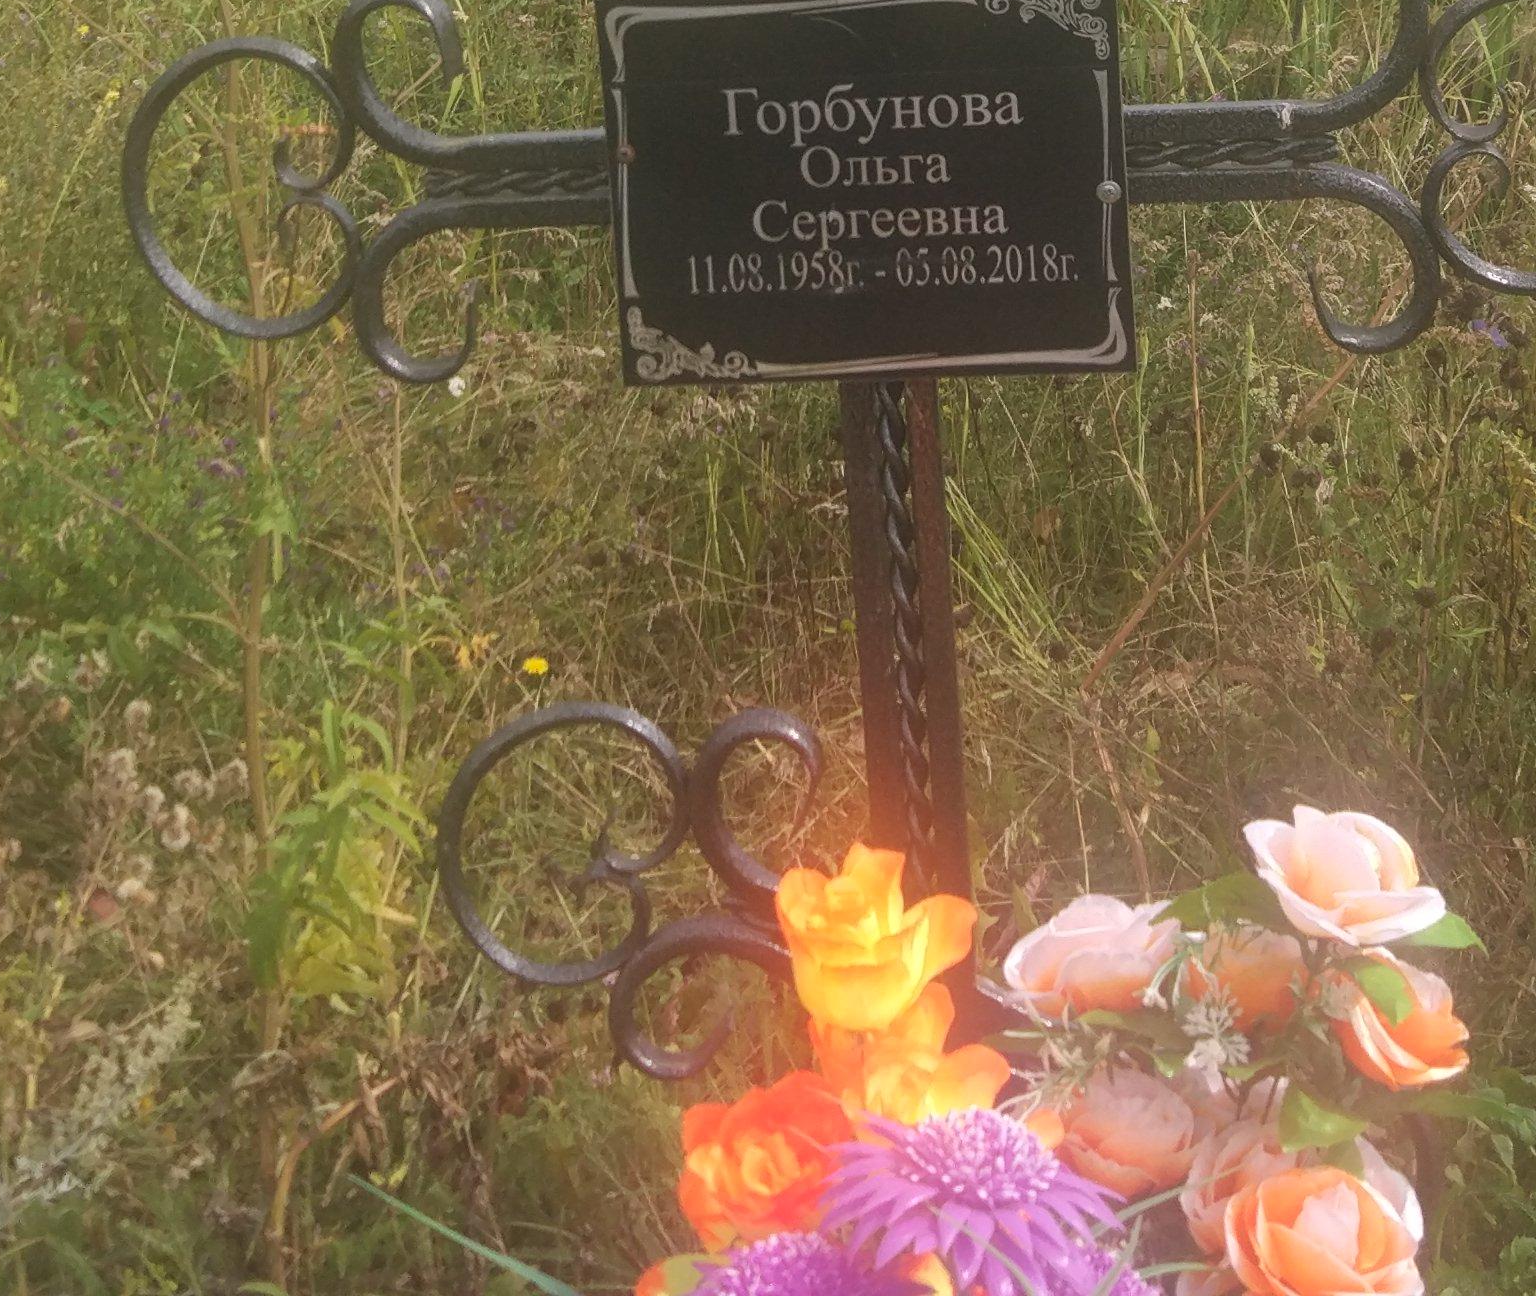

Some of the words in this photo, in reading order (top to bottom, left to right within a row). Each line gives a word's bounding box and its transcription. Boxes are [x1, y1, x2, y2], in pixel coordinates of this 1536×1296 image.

[721, 83, 1024, 147] Горбунова
[799, 145, 951, 188] Ольга
[752, 200, 1009, 252] Сергеевна
[688, 249, 864, 295] 11.08.1958г.
[896, 242, 1079, 287] 05.08.2018г.
